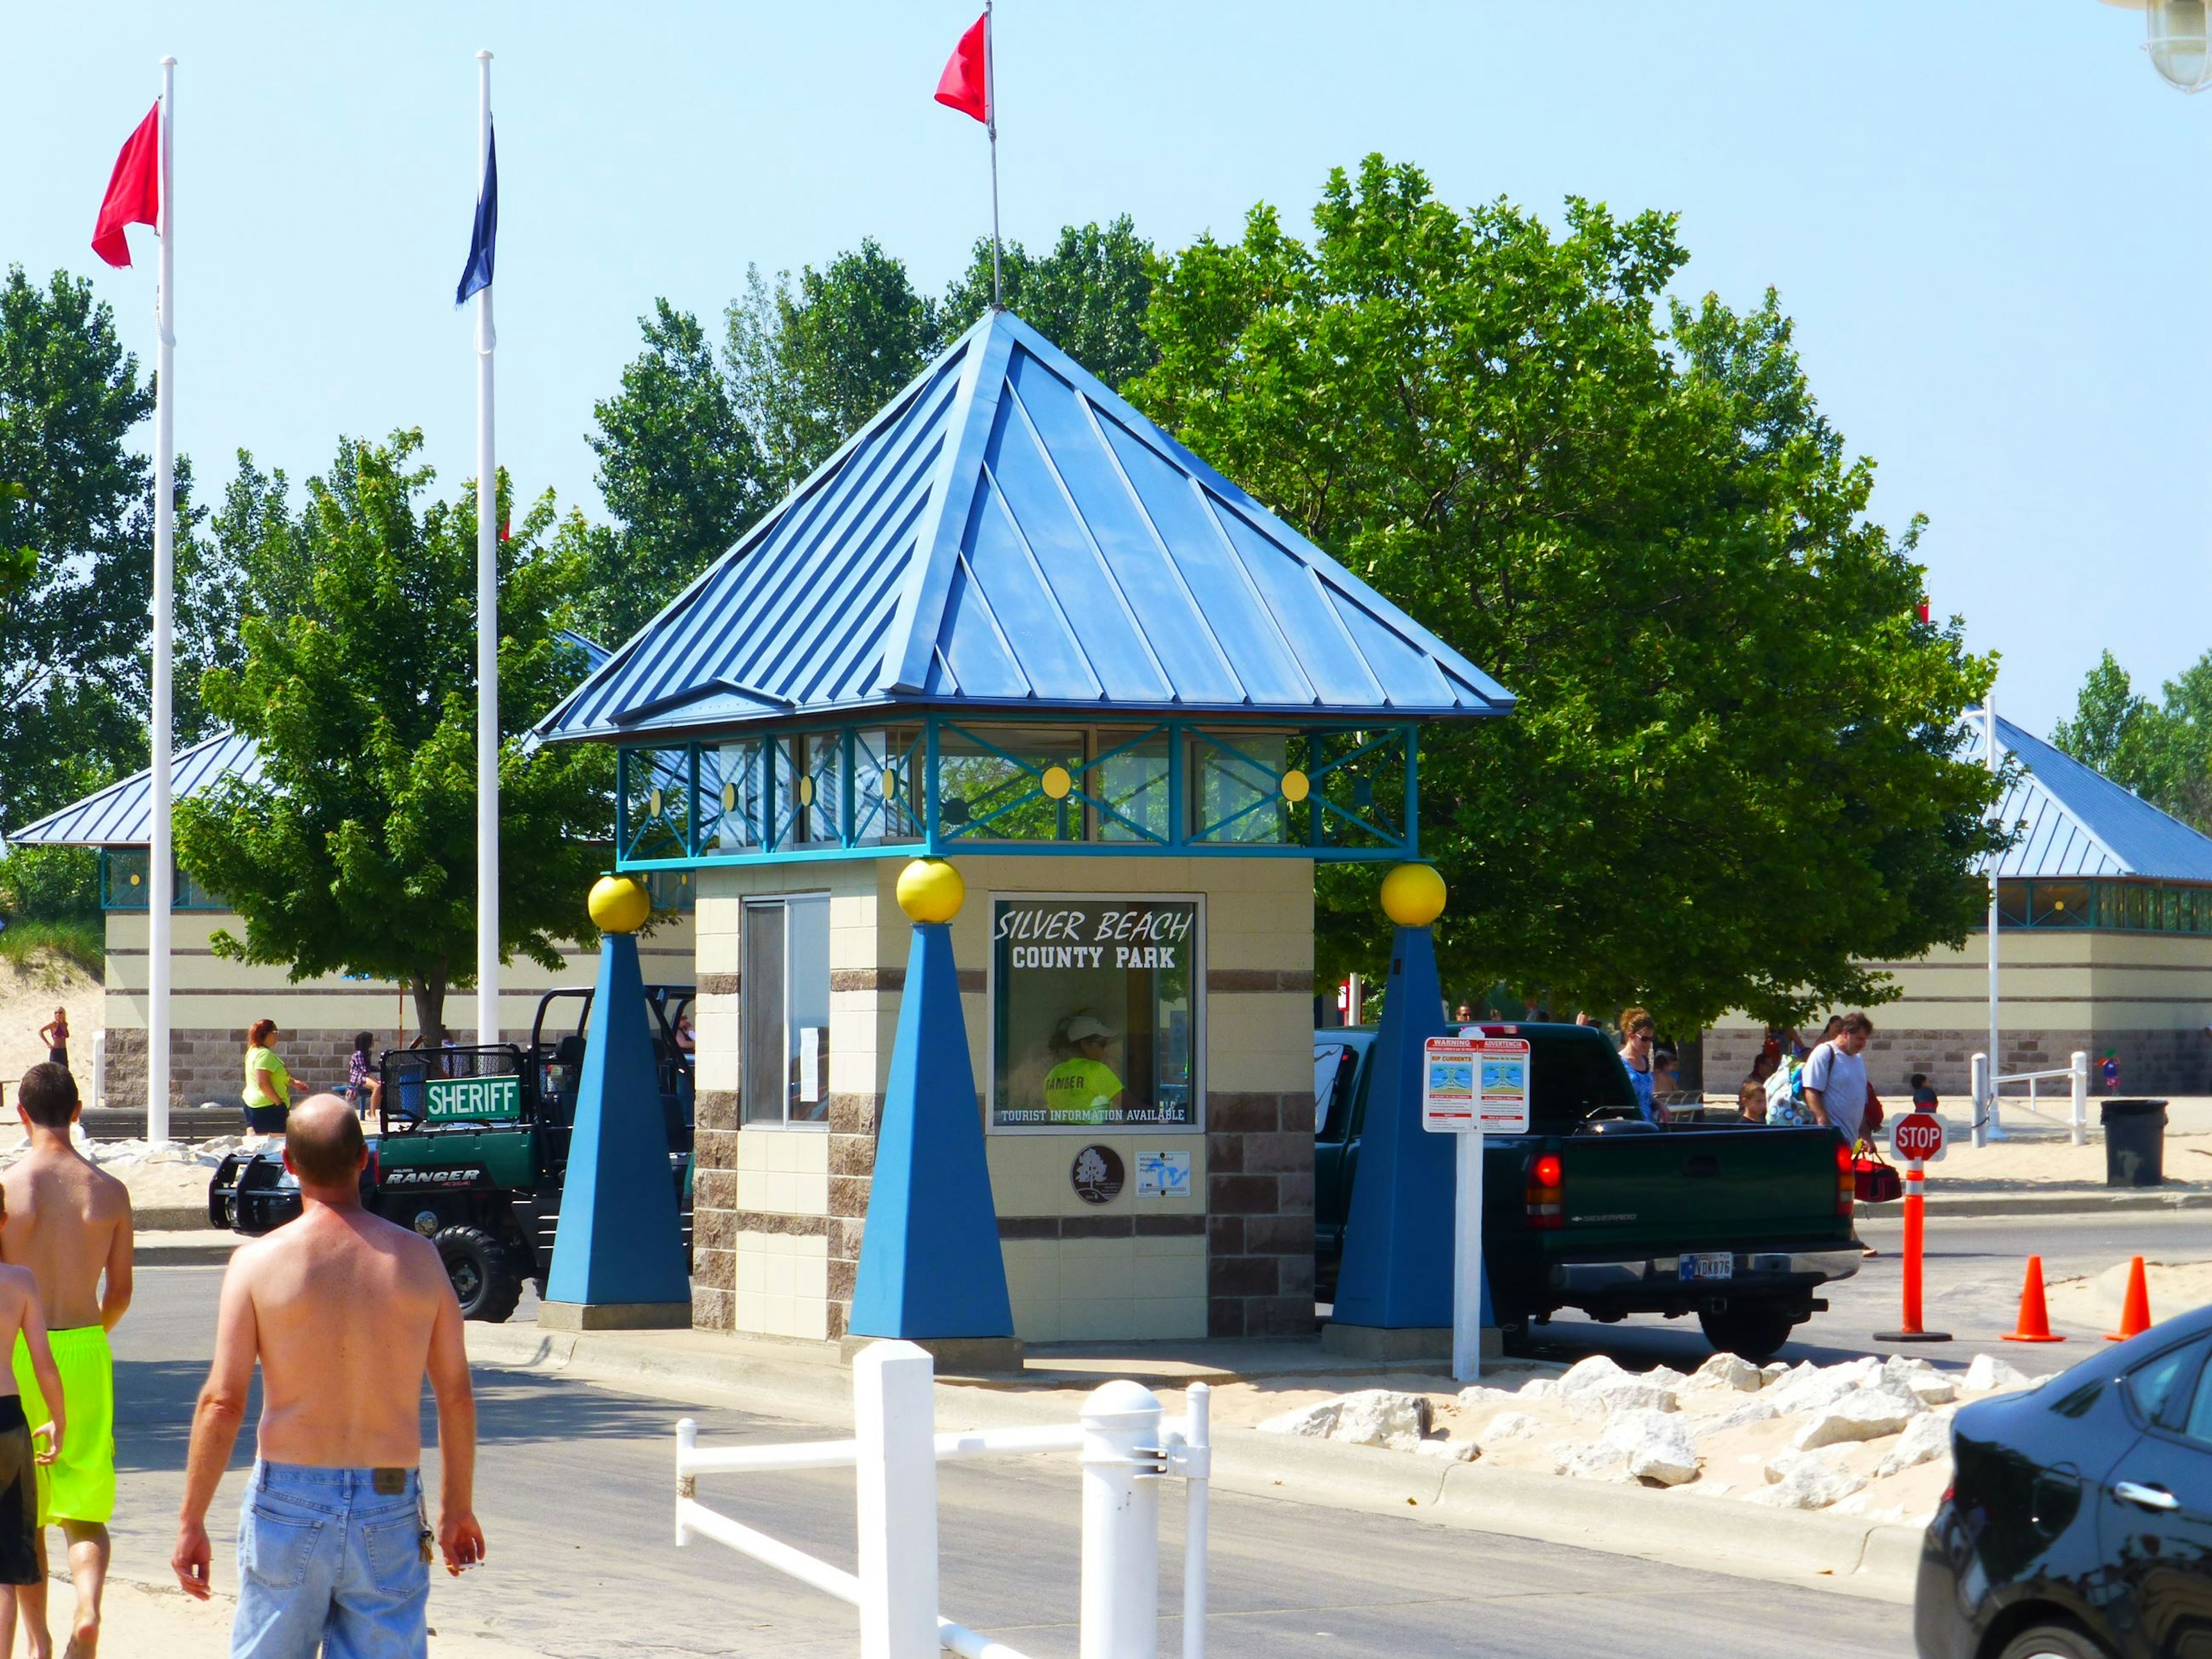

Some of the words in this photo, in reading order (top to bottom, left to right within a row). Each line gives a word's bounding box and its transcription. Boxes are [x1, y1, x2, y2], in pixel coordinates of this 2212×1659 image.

[995, 909, 1085, 941] SILVER
[1094, 910, 1194, 942] BEACH
[1013, 946, 1103, 968] COUNTY
[1116, 946, 1175, 968] PARK
[428, 1081, 517, 1115] SHERIFF
[1001, 1110, 1046, 1121] TOURIST
[1050, 1109, 1123, 1121] INFORMATION
[1126, 1109, 1185, 1120] AVAILABLE
[1898, 1127, 1940, 1147] STOP
[385, 1169, 480, 1184] RANGER
